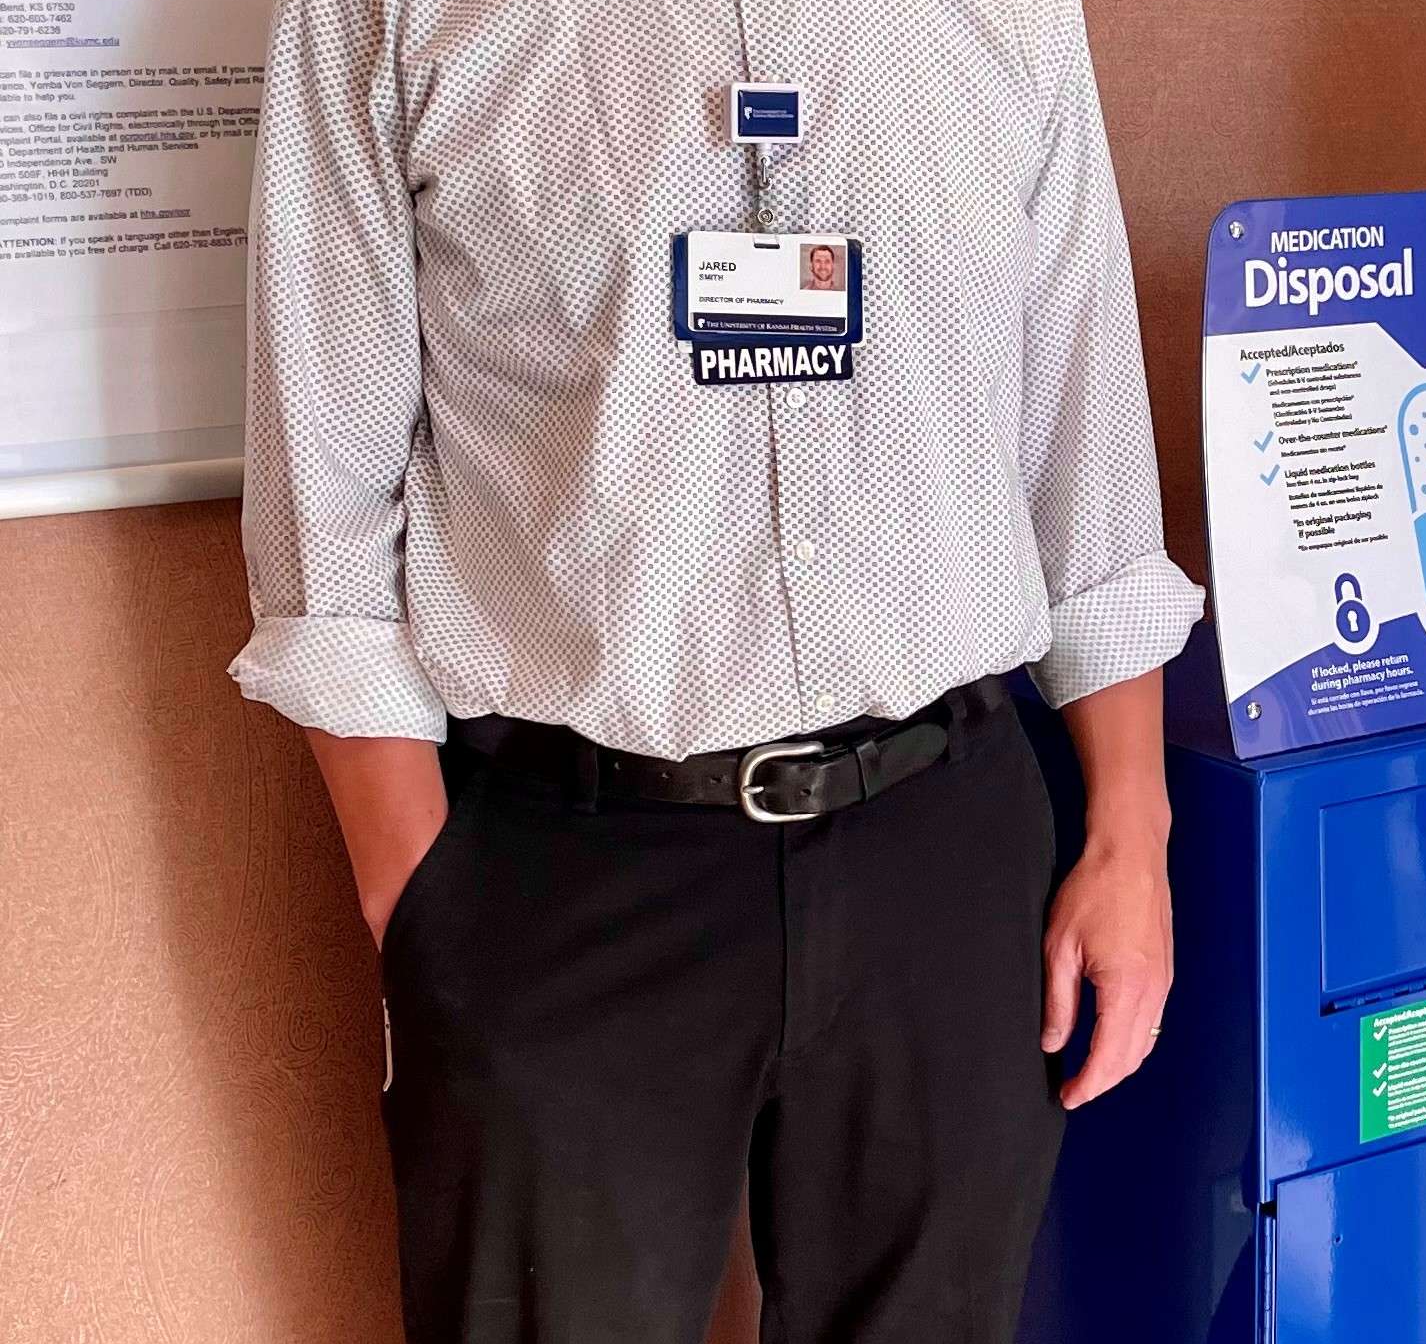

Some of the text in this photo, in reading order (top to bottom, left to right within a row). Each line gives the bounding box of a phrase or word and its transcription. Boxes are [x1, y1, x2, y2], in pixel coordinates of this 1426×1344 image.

[1271, 225, 1384, 254] MEDICATION
[699, 260, 737, 272] JARED
[699, 273, 724, 282] SMITH
[1244, 247, 1414, 316] Disposal
[699, 296, 734, 304] DIRECTOR
[700, 344, 847, 381] PHARMACY
[1240, 341, 1345, 362] Accepted/Aceptados
[1266, 366, 1310, 379] Prescription
[1312, 666, 1319, 679] If
[1352, 658, 1381, 675] please
[1382, 654, 1409, 668] return
[1311, 665, 1414, 693] during pharmacy hours.
